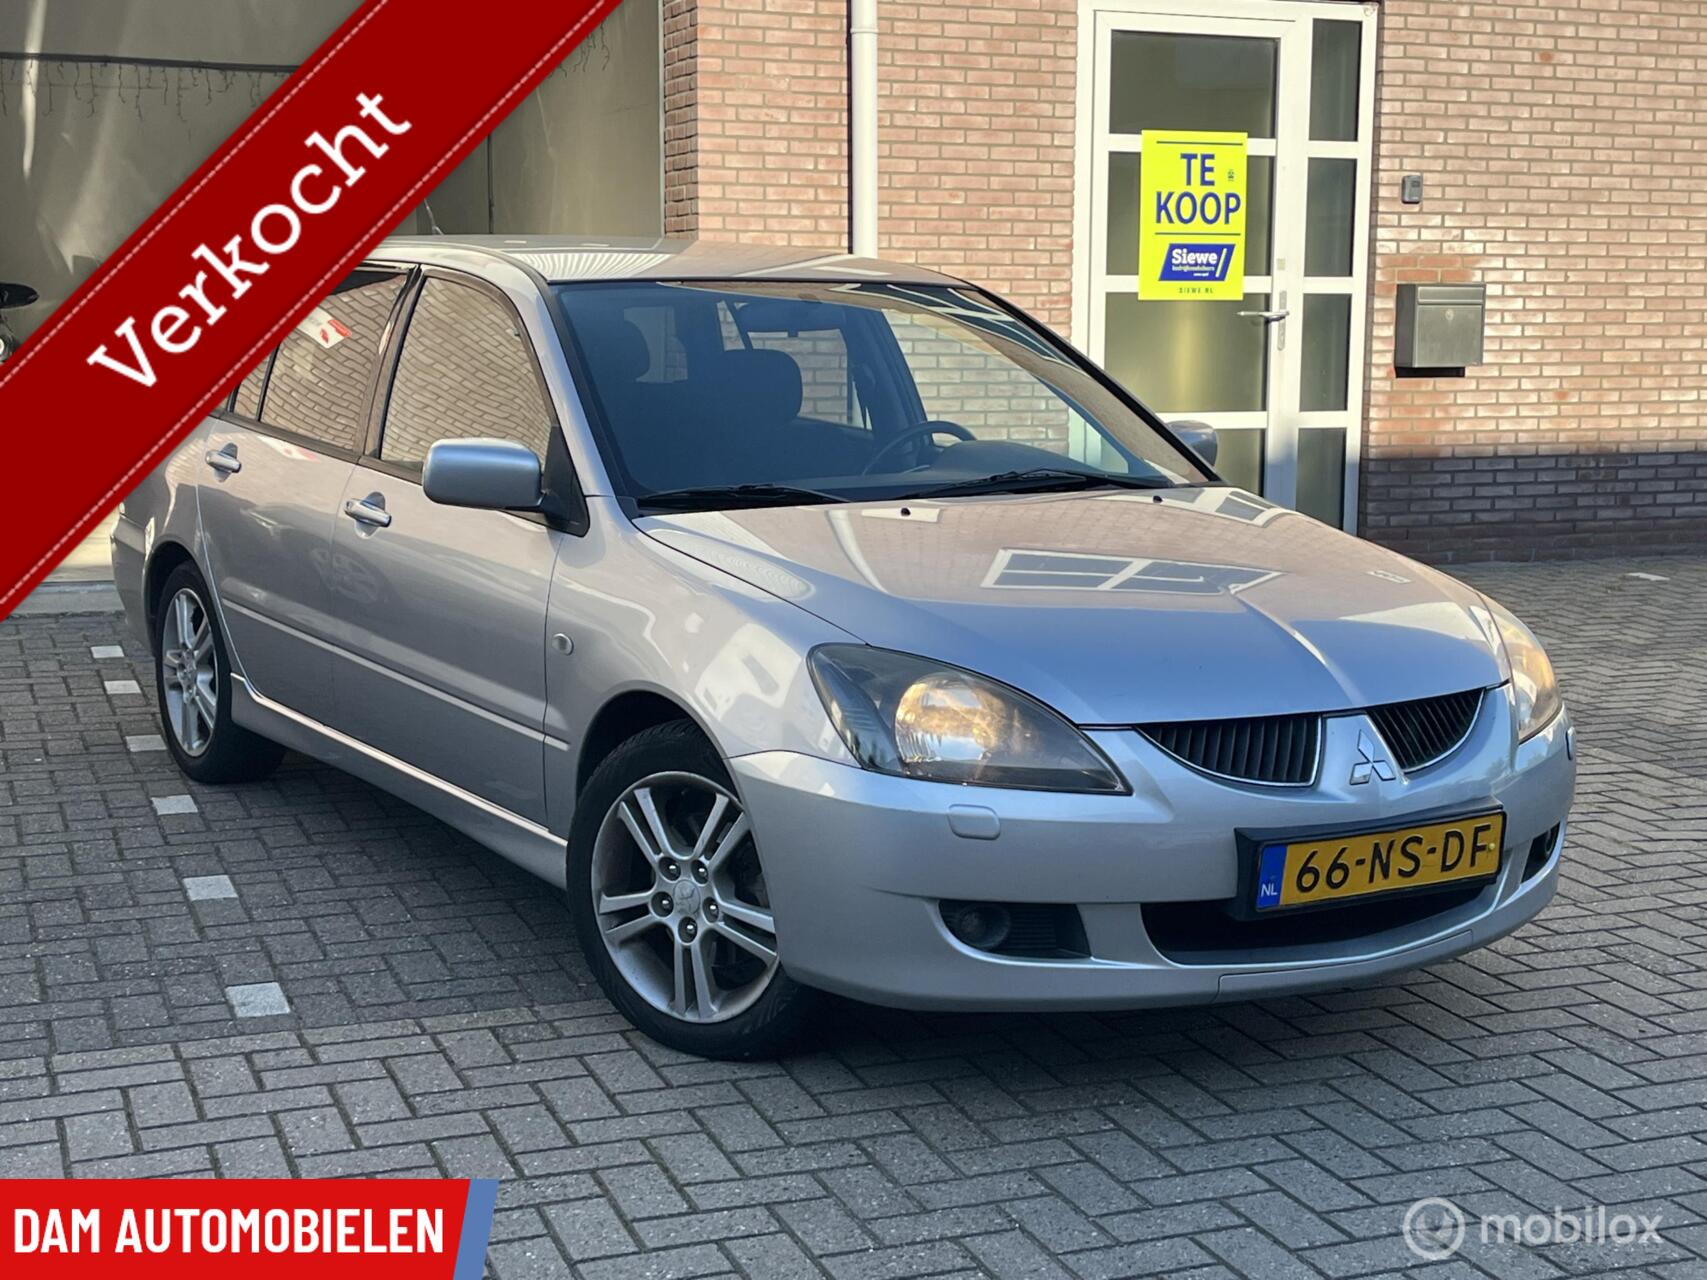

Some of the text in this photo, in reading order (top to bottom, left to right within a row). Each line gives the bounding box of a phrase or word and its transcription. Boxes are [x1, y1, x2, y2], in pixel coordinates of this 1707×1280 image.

[1180, 153, 1215, 186] TE
[1156, 191, 1241, 225] KOOP
[1171, 248, 1218, 265] Siewe
[1296, 823, 1492, 893] 66-NS-DF
[1261, 883, 1278, 898] NL
